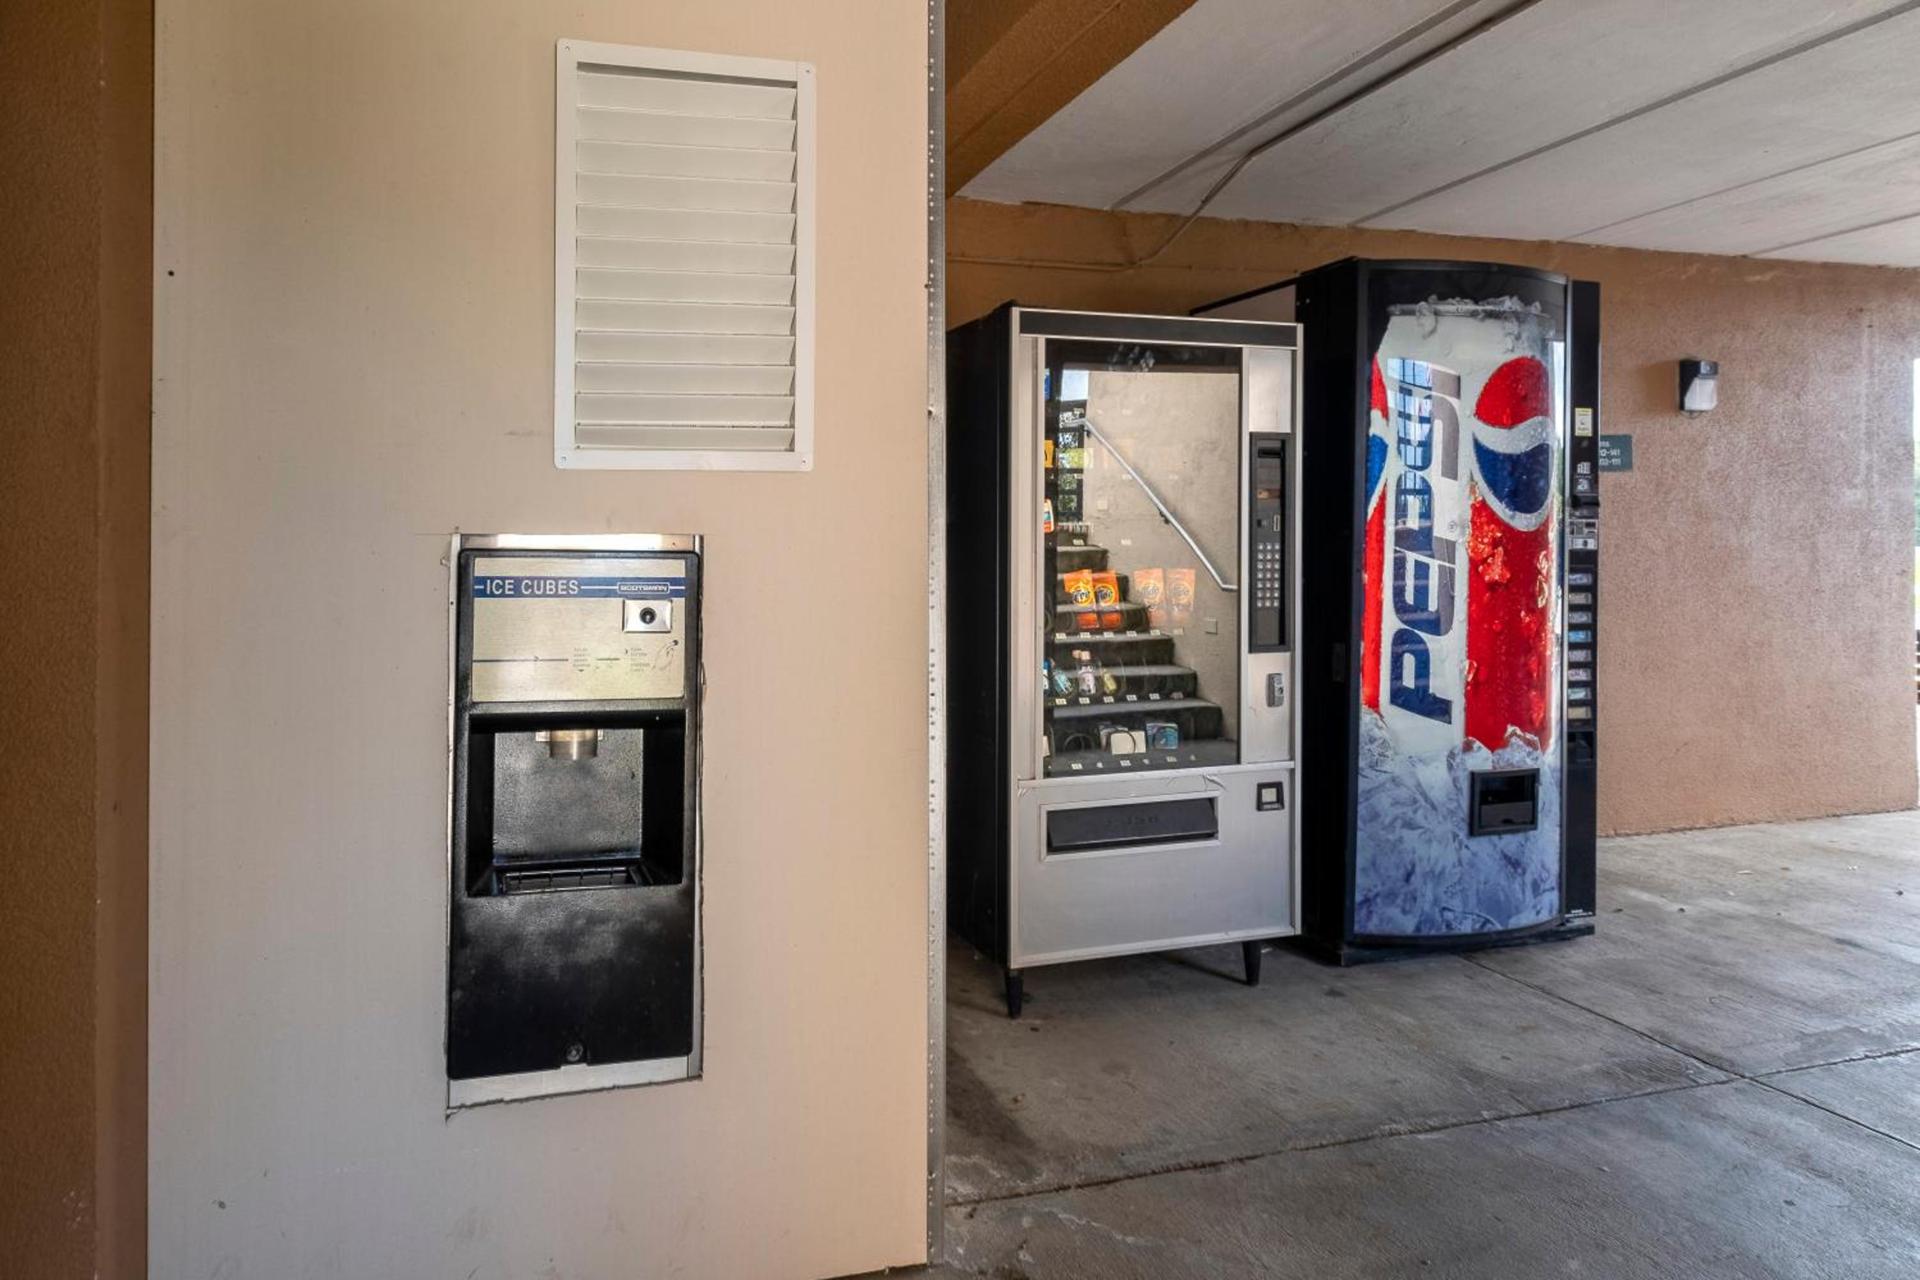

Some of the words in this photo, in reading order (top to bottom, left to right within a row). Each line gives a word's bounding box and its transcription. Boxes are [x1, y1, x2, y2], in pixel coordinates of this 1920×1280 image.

[486, 579, 514, 594] ICE
[521, 579, 579, 595] CUBES
[1390, 357, 1461, 725] PEPSI
